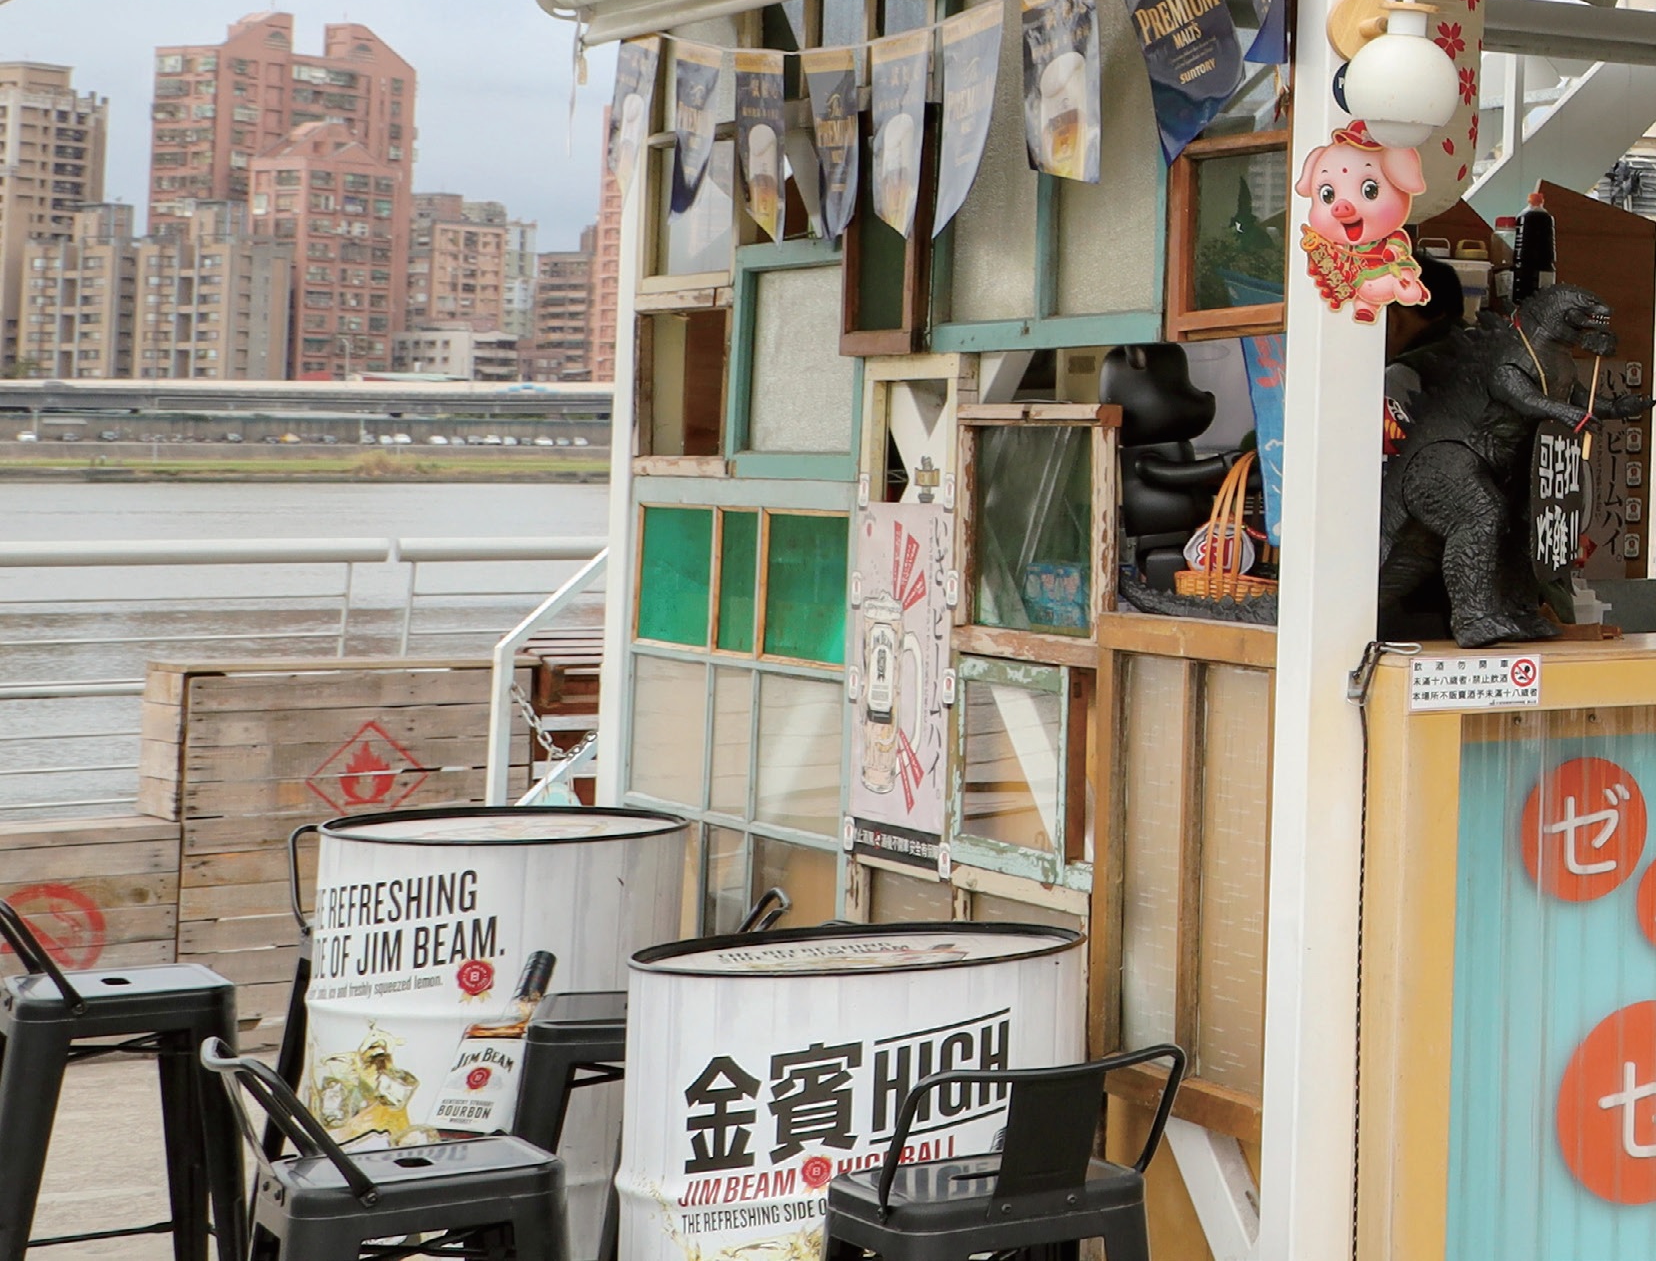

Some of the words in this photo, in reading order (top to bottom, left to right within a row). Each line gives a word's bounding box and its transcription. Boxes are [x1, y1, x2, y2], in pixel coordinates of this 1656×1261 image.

[1173, 21, 1202, 50] MALT'S
[1539, 434, 1581, 500] 哥吉拉
[328, 869, 478, 930] REFRESHING
[331, 934, 352, 979] OF
[356, 929, 404, 975] JIM
[412, 914, 506, 969] BEAM.
[452, 1052, 480, 1072] JIM
[482, 1046, 516, 1073] BEAM
[437, 1104, 493, 1120] BOURBON
[684, 1041, 864, 1174] 金賓
[871, 1019, 1012, 1135] HIGH
[678, 1174, 722, 1207] JIM
[723, 1167, 798, 1204] BEAM
[682, 1214, 702, 1234] THE
[703, 1205, 780, 1232] REFRESHING
[784, 1199, 816, 1222] SIDE
